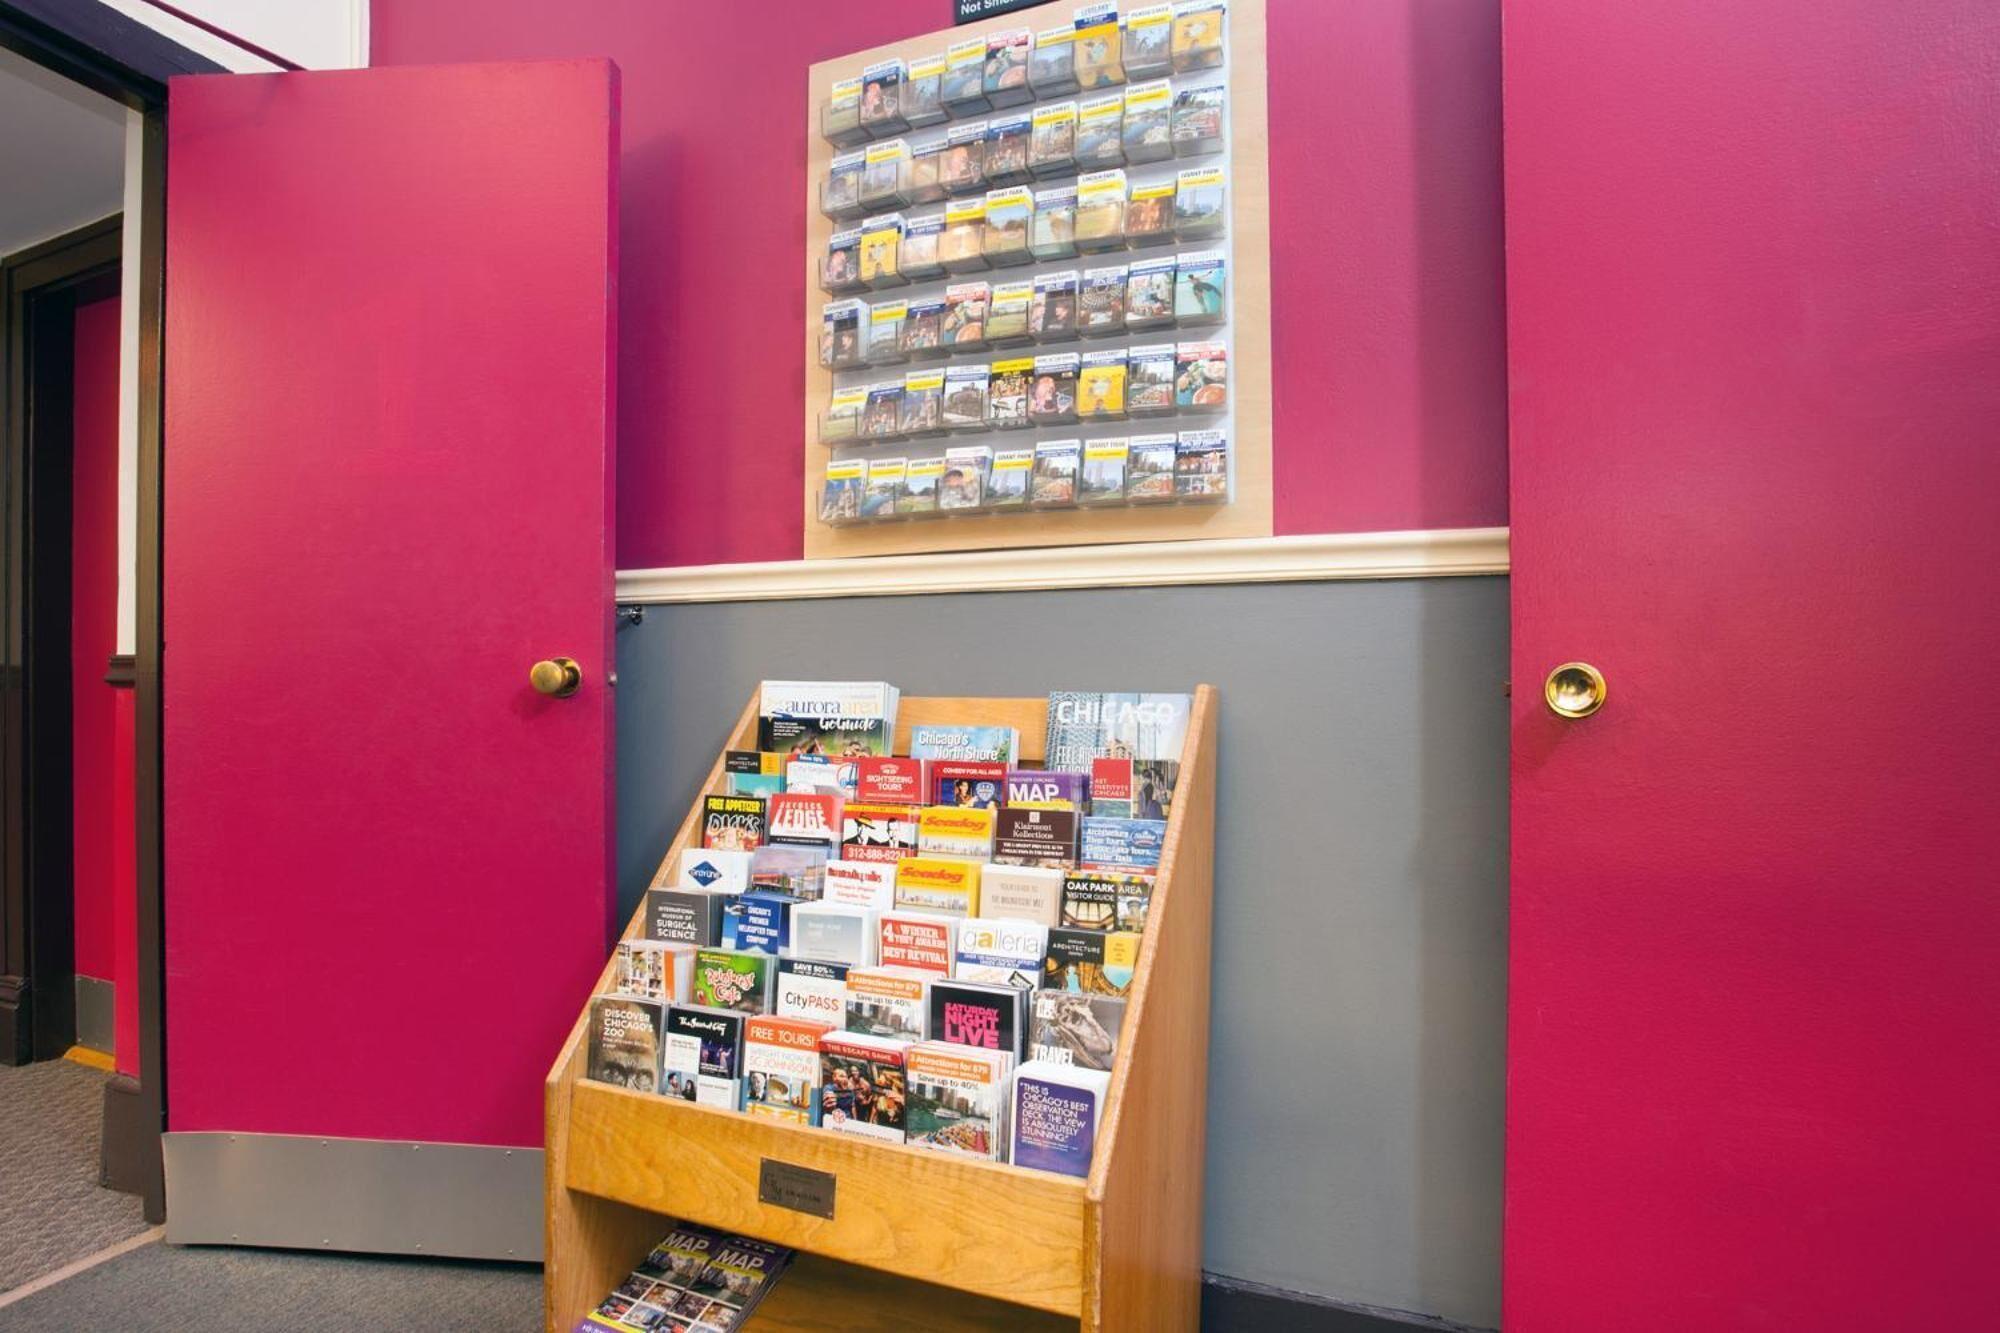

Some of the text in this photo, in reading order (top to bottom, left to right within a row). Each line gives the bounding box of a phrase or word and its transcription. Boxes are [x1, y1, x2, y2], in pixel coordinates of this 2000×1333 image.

[961, 2, 981, 15] Not
[1056, 701, 1175, 724] CHICAGO
[819, 717, 878, 731] GoGuide
[918, 730, 970, 747] Chicago's
[934, 746, 999, 761] North Shore
[866, 774, 914, 785] SIGHTSEEING
[943, 767, 965, 775] COMEDY
[877, 782, 903, 792] TOURS
[1009, 783, 1060, 802] MAP
[708, 798, 760, 813] FREE APPETIZER
[709, 813, 761, 833] DICK'S
[770, 807, 826, 831] LEDGE
[924, 816, 987, 833] Seadog
[901, 866, 964, 884] Seadog
[1067, 881, 1143, 895] OAK PARK AREA
[1066, 892, 1115, 902] VISITOR GUIDE
[658, 905, 696, 915] INTERNATIONAL
[656, 919, 698, 931] SURGICAL
[883, 922, 939, 943] 4 WINNER
[657, 929, 696, 940] SCIENCE
[914, 936, 947, 950] AWARDS
[963, 927, 1039, 953] galleria
[883, 945, 905, 960] BEST
[907, 948, 948, 965] REVIVAL
[1052, 942, 1101, 954] ARCHITECTURE
[793, 962, 812, 972] SAVE
[856, 975, 895, 989] Attractions
[785, 991, 840, 1012] CityPASS
[856, 993, 874, 1002] Save
[874, 995, 883, 1004] up
[893, 997, 912, 1008] 40%
[604, 1008, 651, 1021] DISCOVER
[945, 1002, 999, 1019] SATURDAY
[603, 1018, 654, 1033] CHICAGO'S
[690, 1017, 713, 1030] Second
[712, 1023, 727, 1037] City
[944, 1011, 999, 1031] NIGHT
[602, 1027, 625, 1038] ZOO
[750, 1026, 816, 1048] FREE TOURS!
[944, 1022, 1000, 1049] LIVE
[827, 1043, 841, 1051] THE
[842, 1046, 870, 1057] ESCAPE
[871, 1051, 893, 1061] GAME
[1033, 1043, 1073, 1065] TRAVEL
[916, 1055, 960, 1070] Attractions
[960, 1061, 972, 1071] for
[918, 1073, 979, 1090] Save up to 40%
[1041, 1087, 1049, 1096] IS
[1022, 1100, 1078, 1118] OBSERVATION
[1023, 1091, 1089, 1112] CHICAGO'S BEST
[1022, 1117, 1079, 1137] IS ABSOLUTELY
[1047, 1114, 1063, 1124] THE
[1064, 1117, 1086, 1129] VIEW
[661, 1232, 711, 1252] MAP
[715, 1248, 765, 1270] MAP
